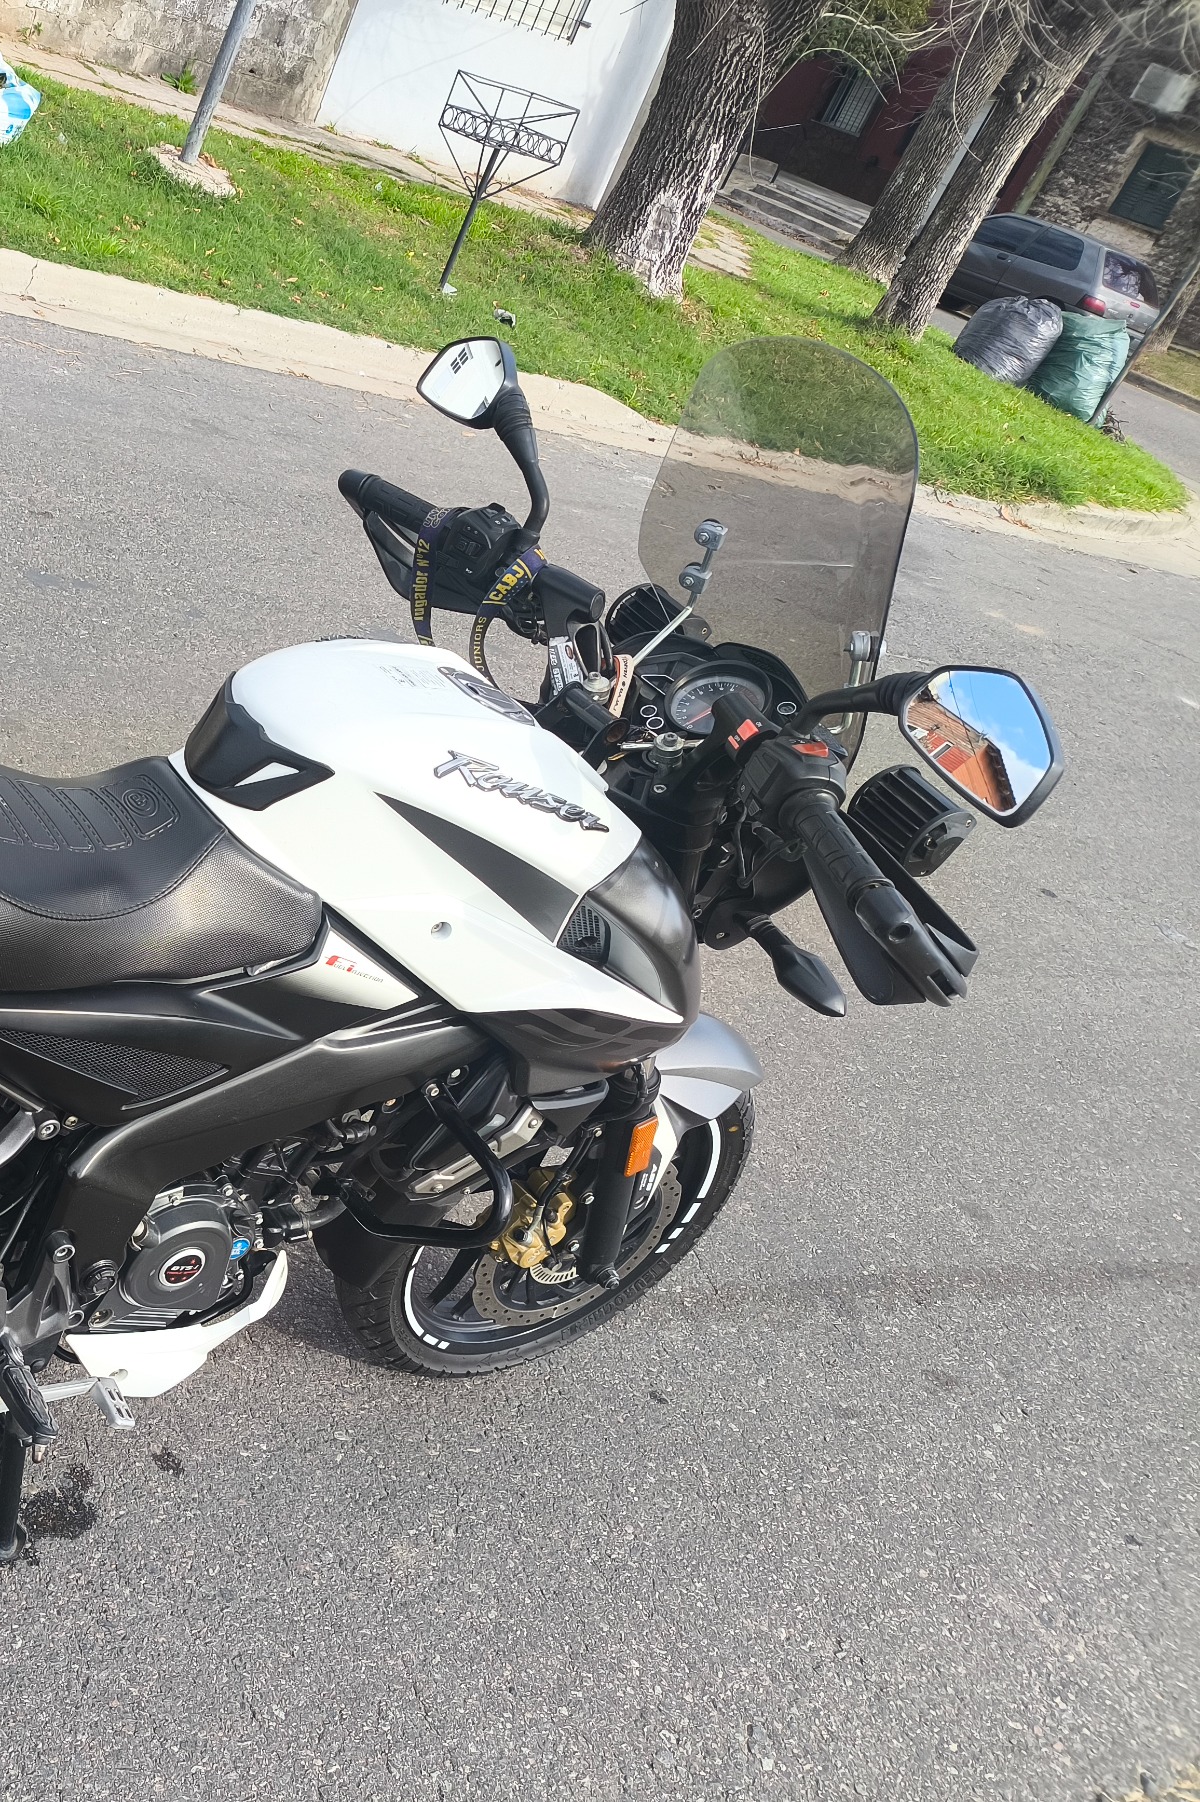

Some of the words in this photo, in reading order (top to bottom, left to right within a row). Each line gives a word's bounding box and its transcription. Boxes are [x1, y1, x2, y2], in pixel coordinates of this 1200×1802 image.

[489, 564, 525, 601] CABJ
[474, 616, 487, 672] JUNIORS
[433, 750, 610, 833] Rouser
